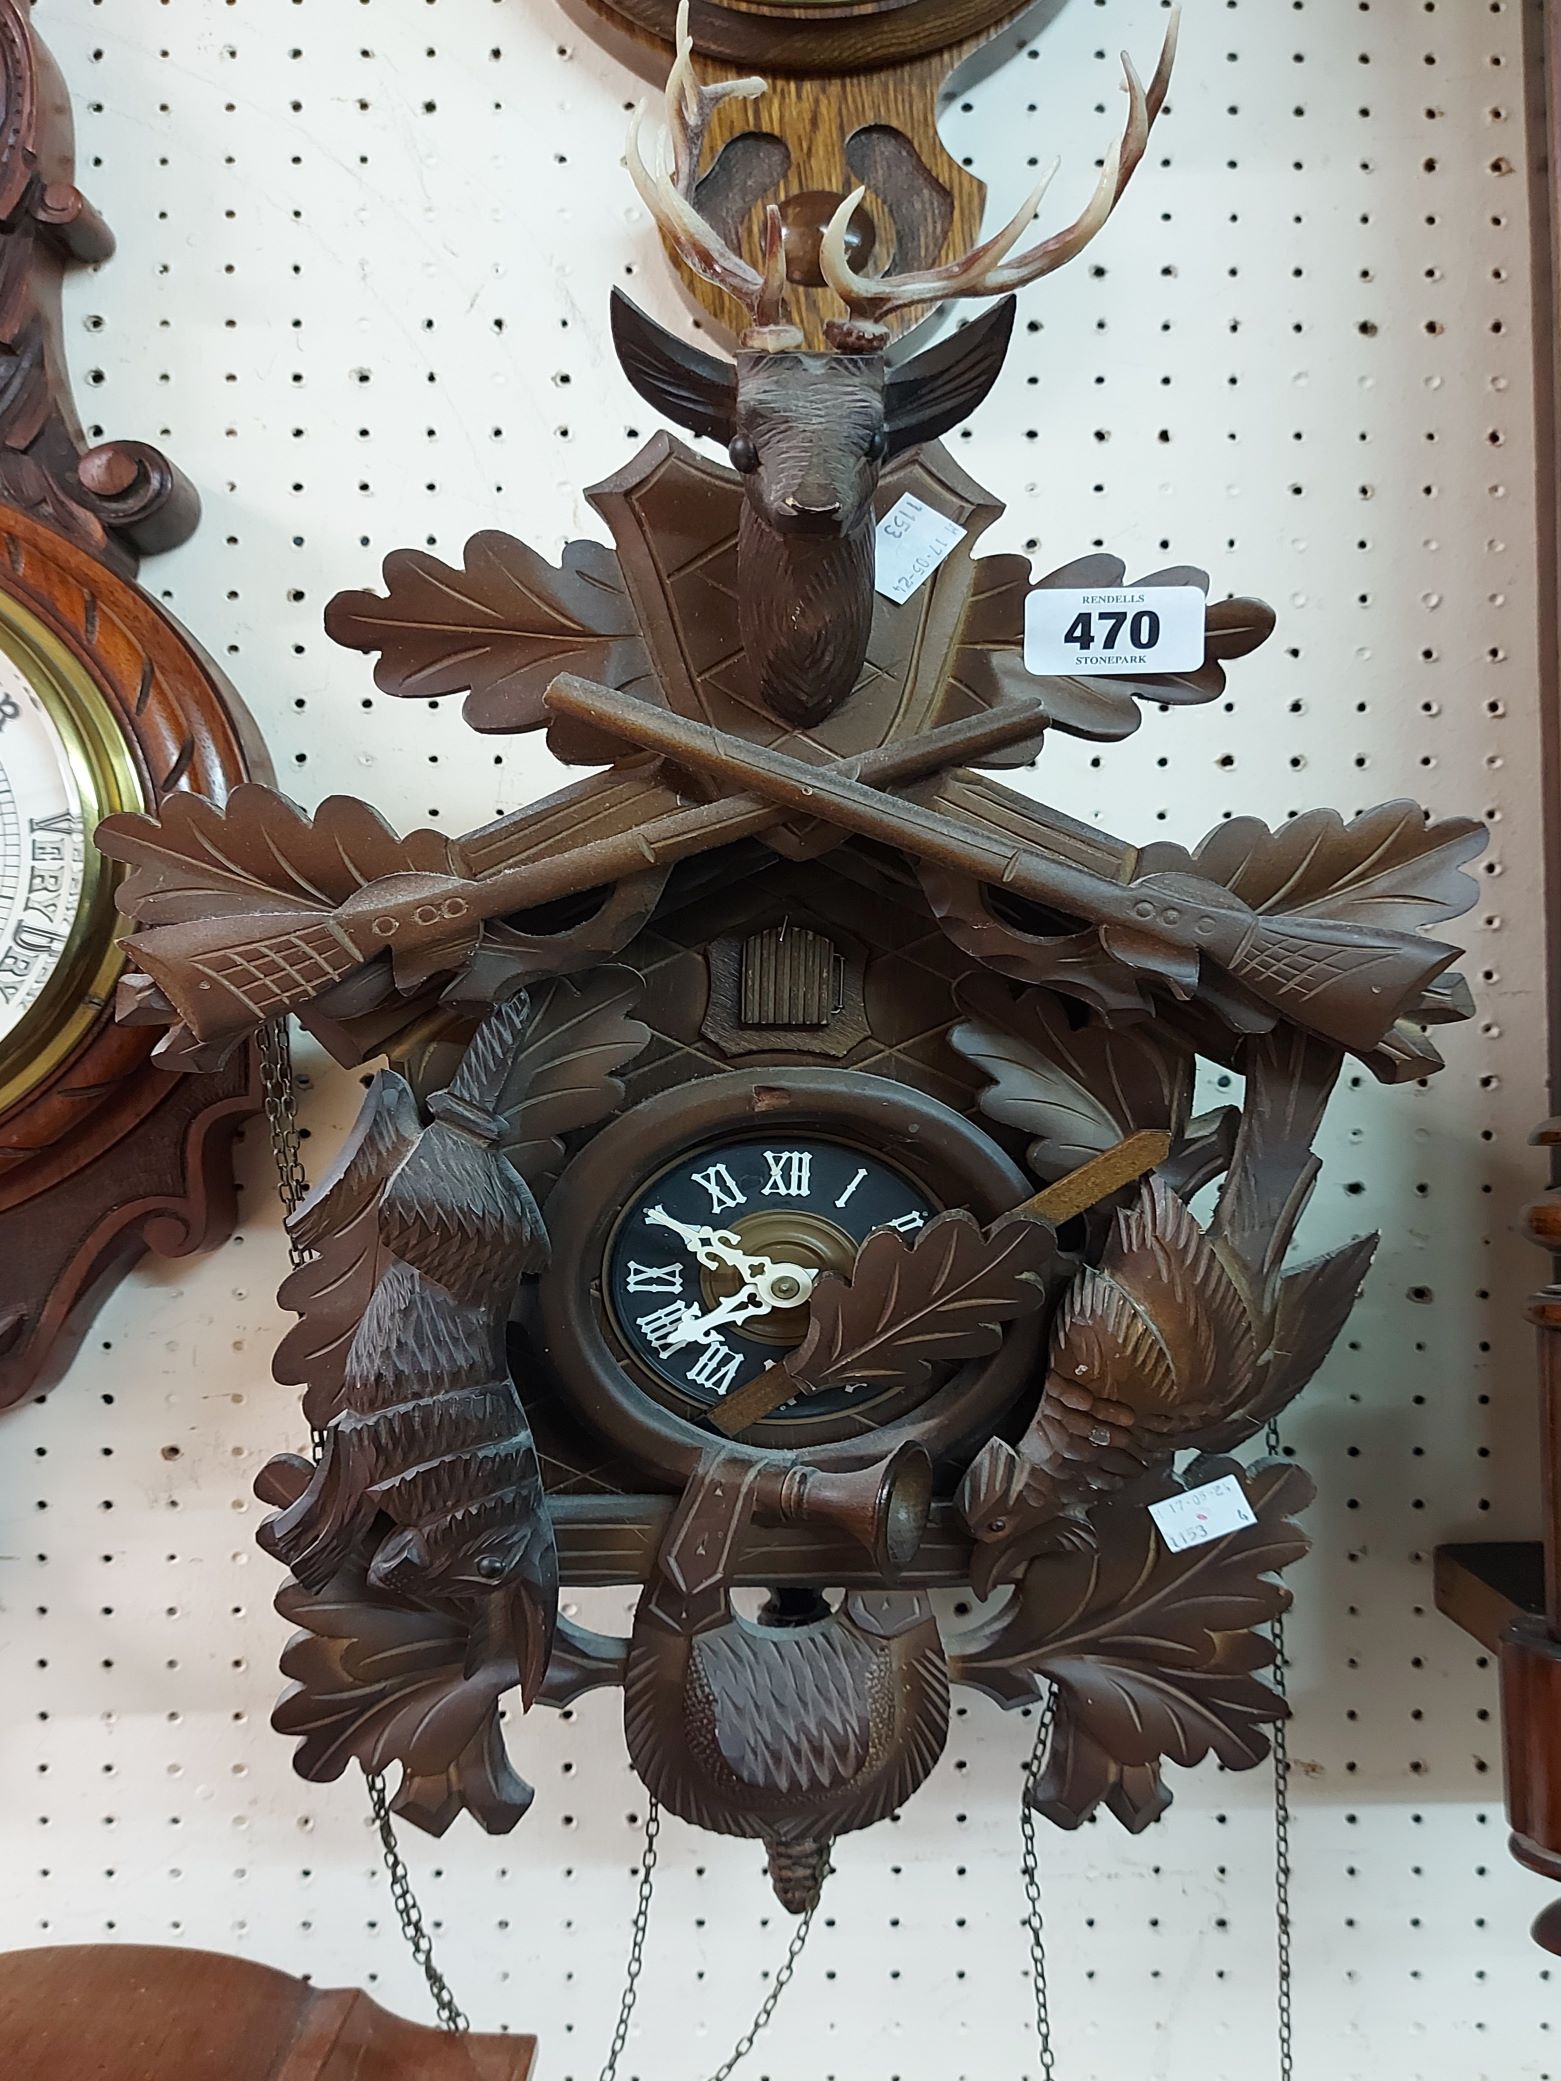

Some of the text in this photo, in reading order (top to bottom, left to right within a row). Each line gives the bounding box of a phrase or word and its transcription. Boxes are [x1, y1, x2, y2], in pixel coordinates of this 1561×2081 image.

[884, 501, 922, 539] 1153
[1082, 594, 1145, 605] RENDELLS
[1063, 610, 1160, 651] 470
[1075, 655, 1147, 665] STONEPARK
[26, 809, 75, 923] VERY
[690, 1163, 748, 1214] XI
[760, 1150, 813, 1197] XII
[625, 1260, 684, 1295] IX
[686, 1341, 745, 1396] VII
